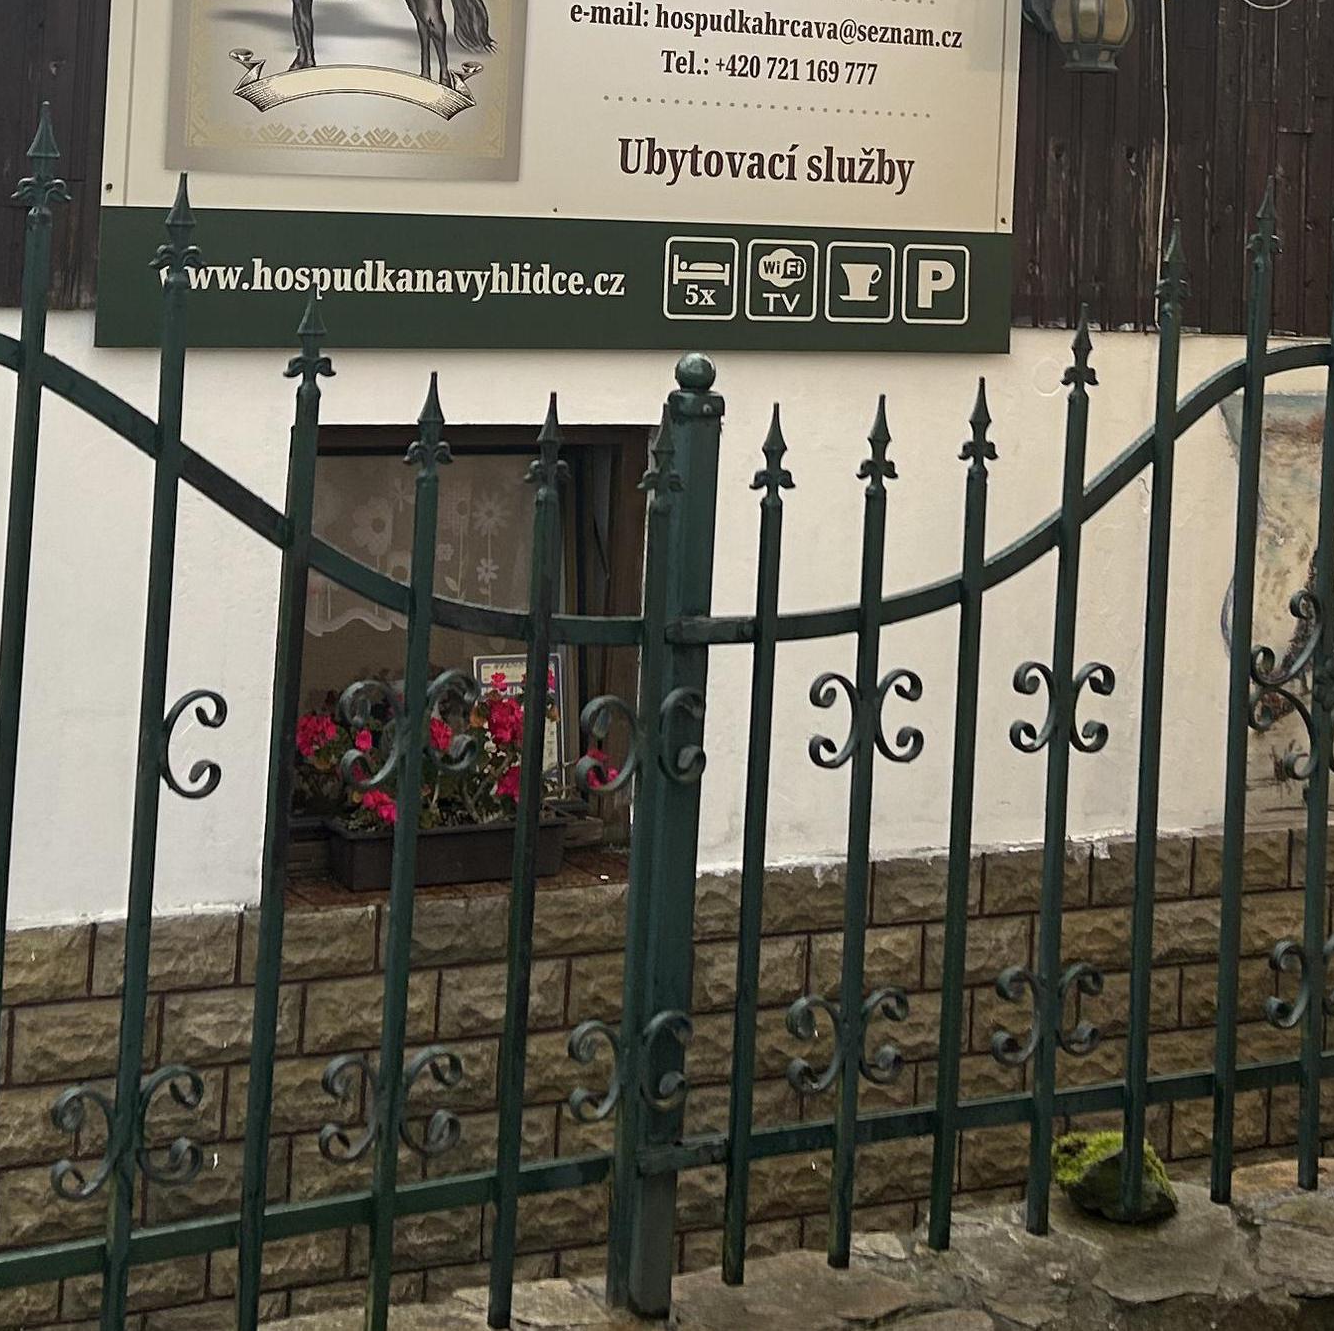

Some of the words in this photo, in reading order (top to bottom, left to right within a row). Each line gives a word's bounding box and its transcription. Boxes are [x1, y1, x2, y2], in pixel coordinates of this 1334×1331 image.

[570, 1, 649, 28] e-mail:
[655, 3, 963, 49] hospudkahrcava@seznam.cz
[661, 50, 709, 75] Tel.:
[715, 55, 761, 78] +420
[766, 57, 800, 81] 721
[806, 59, 839, 84] 169
[844, 62, 878, 85] 777
[618, 138, 798, 186] Ubytovací
[806, 146, 915, 196] služby
[763, 258, 803, 277] WiFi
[917, 260, 956, 309] P
[685, 284, 716, 306] 5x
[763, 293, 801, 313] TV
